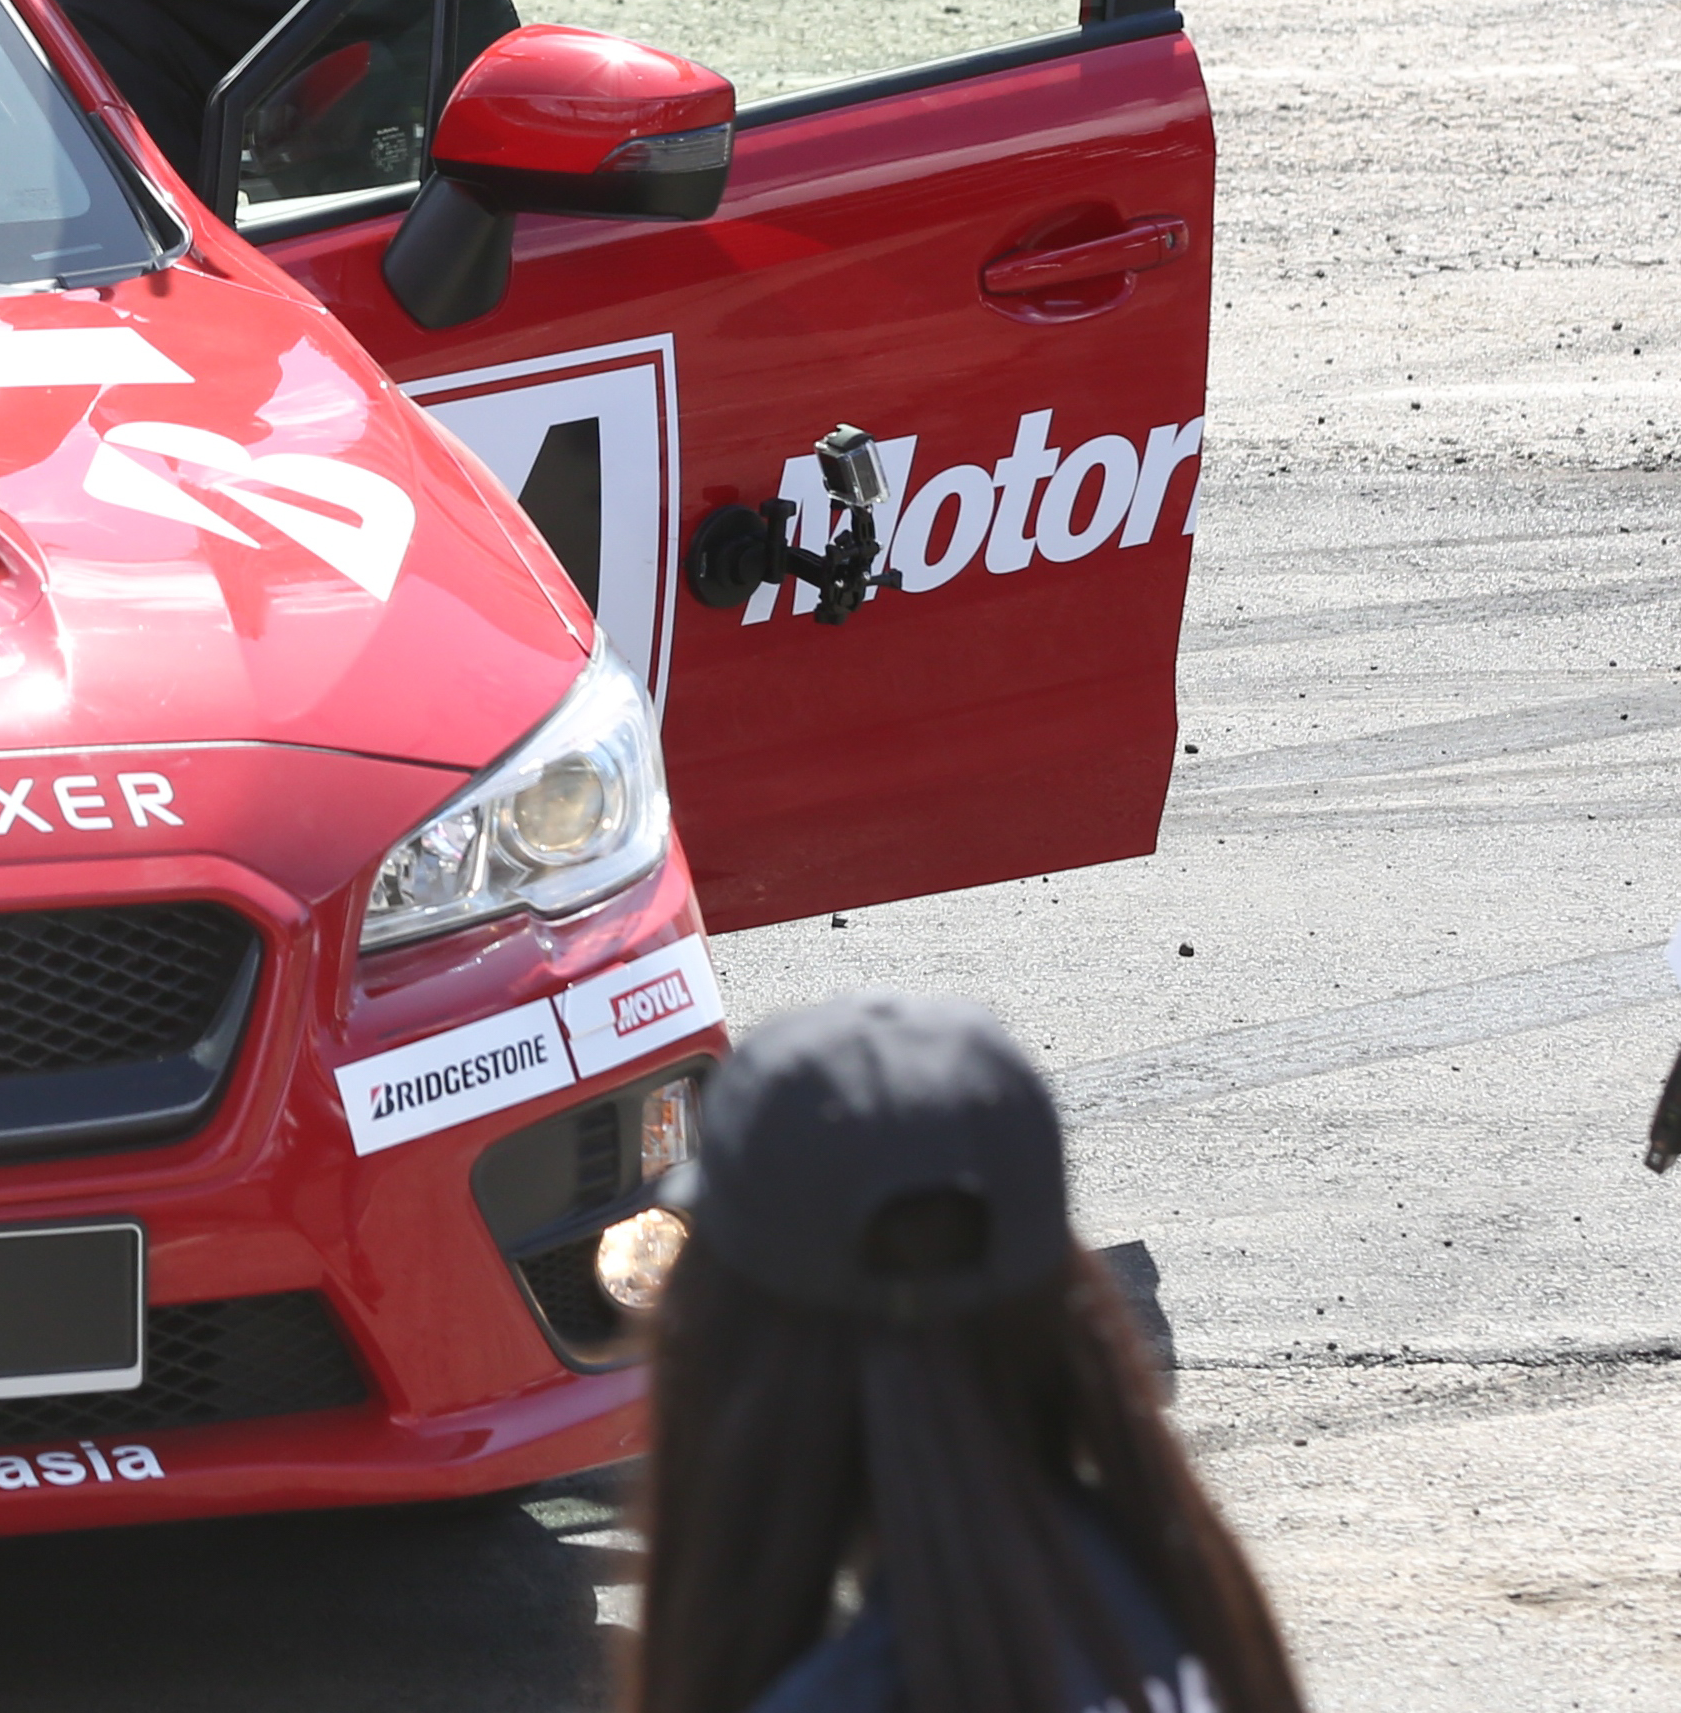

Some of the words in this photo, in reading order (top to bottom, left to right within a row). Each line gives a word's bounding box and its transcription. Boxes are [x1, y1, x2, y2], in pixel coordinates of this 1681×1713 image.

[741, 408, 1204, 627] Motor
[616, 977, 691, 1033] MOTUL
[369, 1034, 549, 1122] BRIDGESTONE
